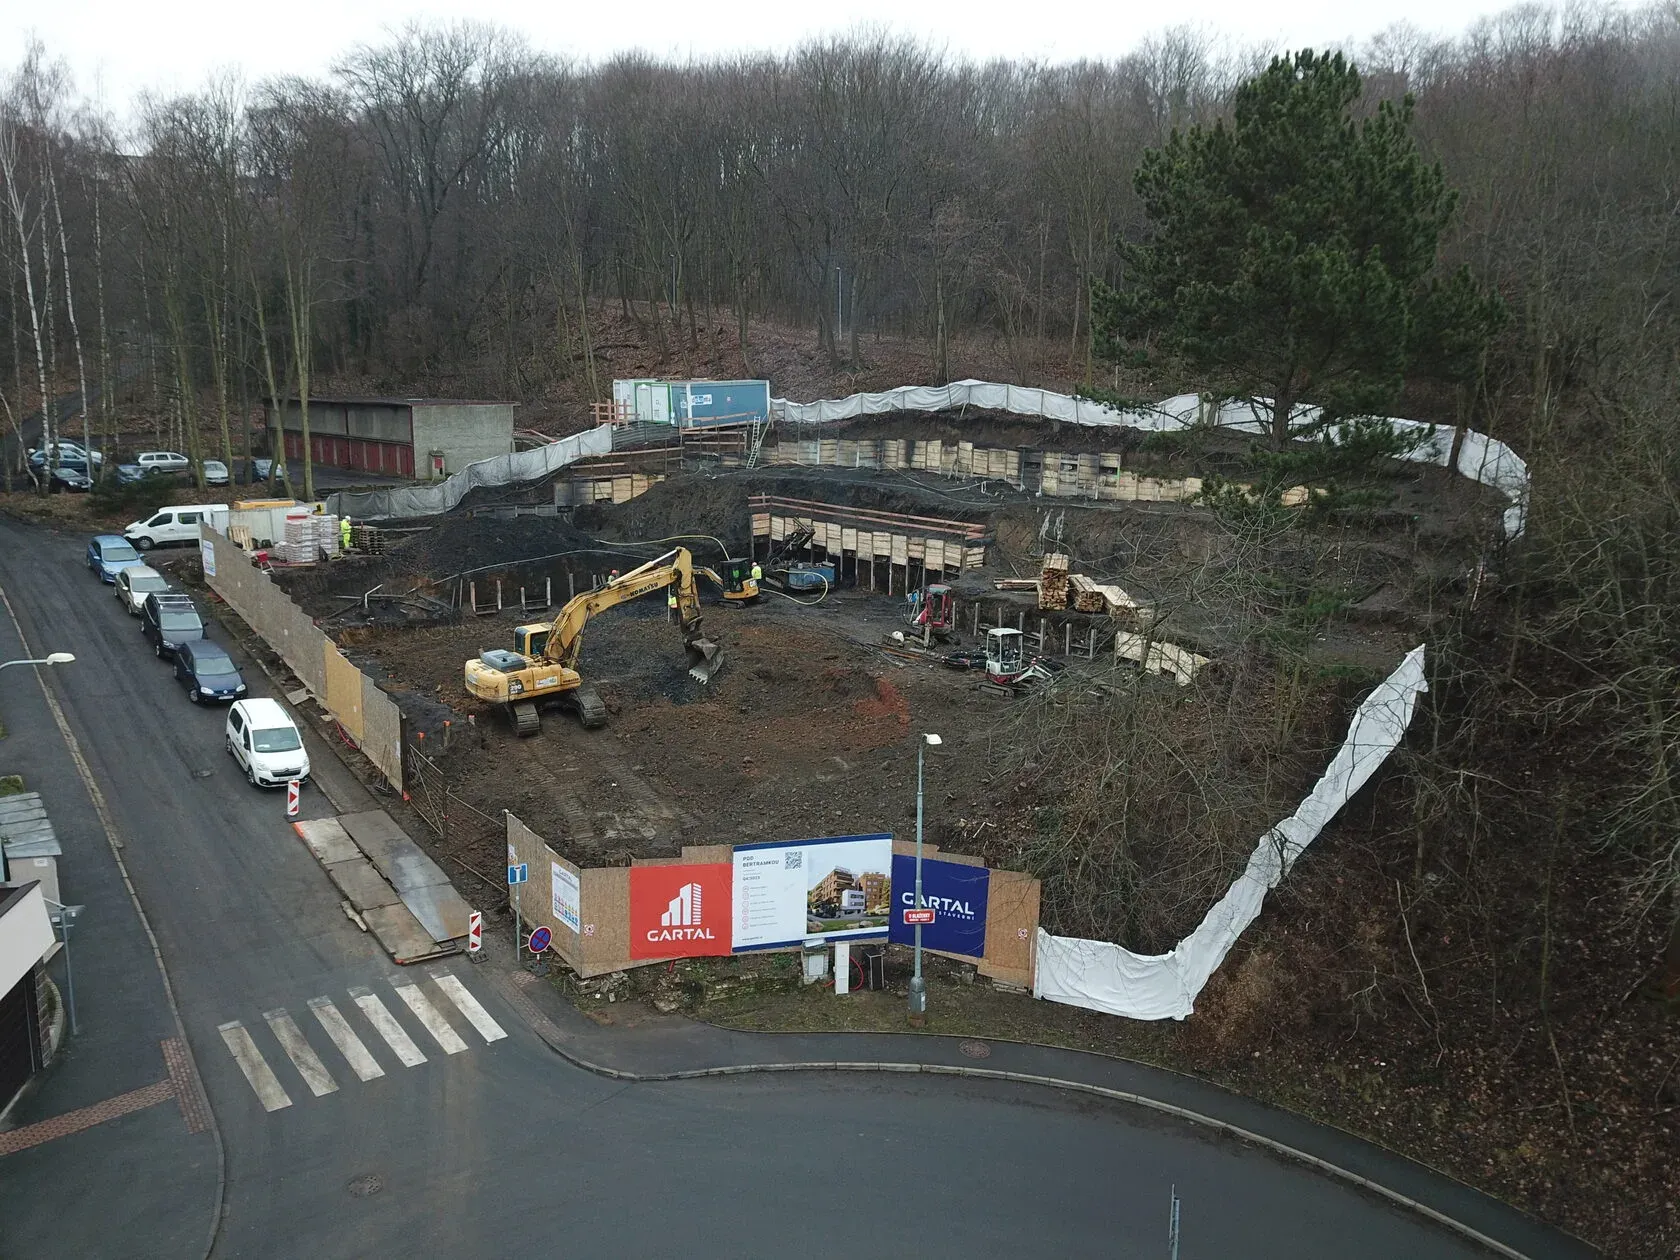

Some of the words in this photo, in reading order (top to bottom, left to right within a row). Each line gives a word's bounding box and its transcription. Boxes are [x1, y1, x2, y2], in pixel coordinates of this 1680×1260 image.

[629, 582, 658, 597] KOMATSU
[742, 860, 780, 868] BERTRAMKOU
[646, 927, 716, 942] GARTAL
